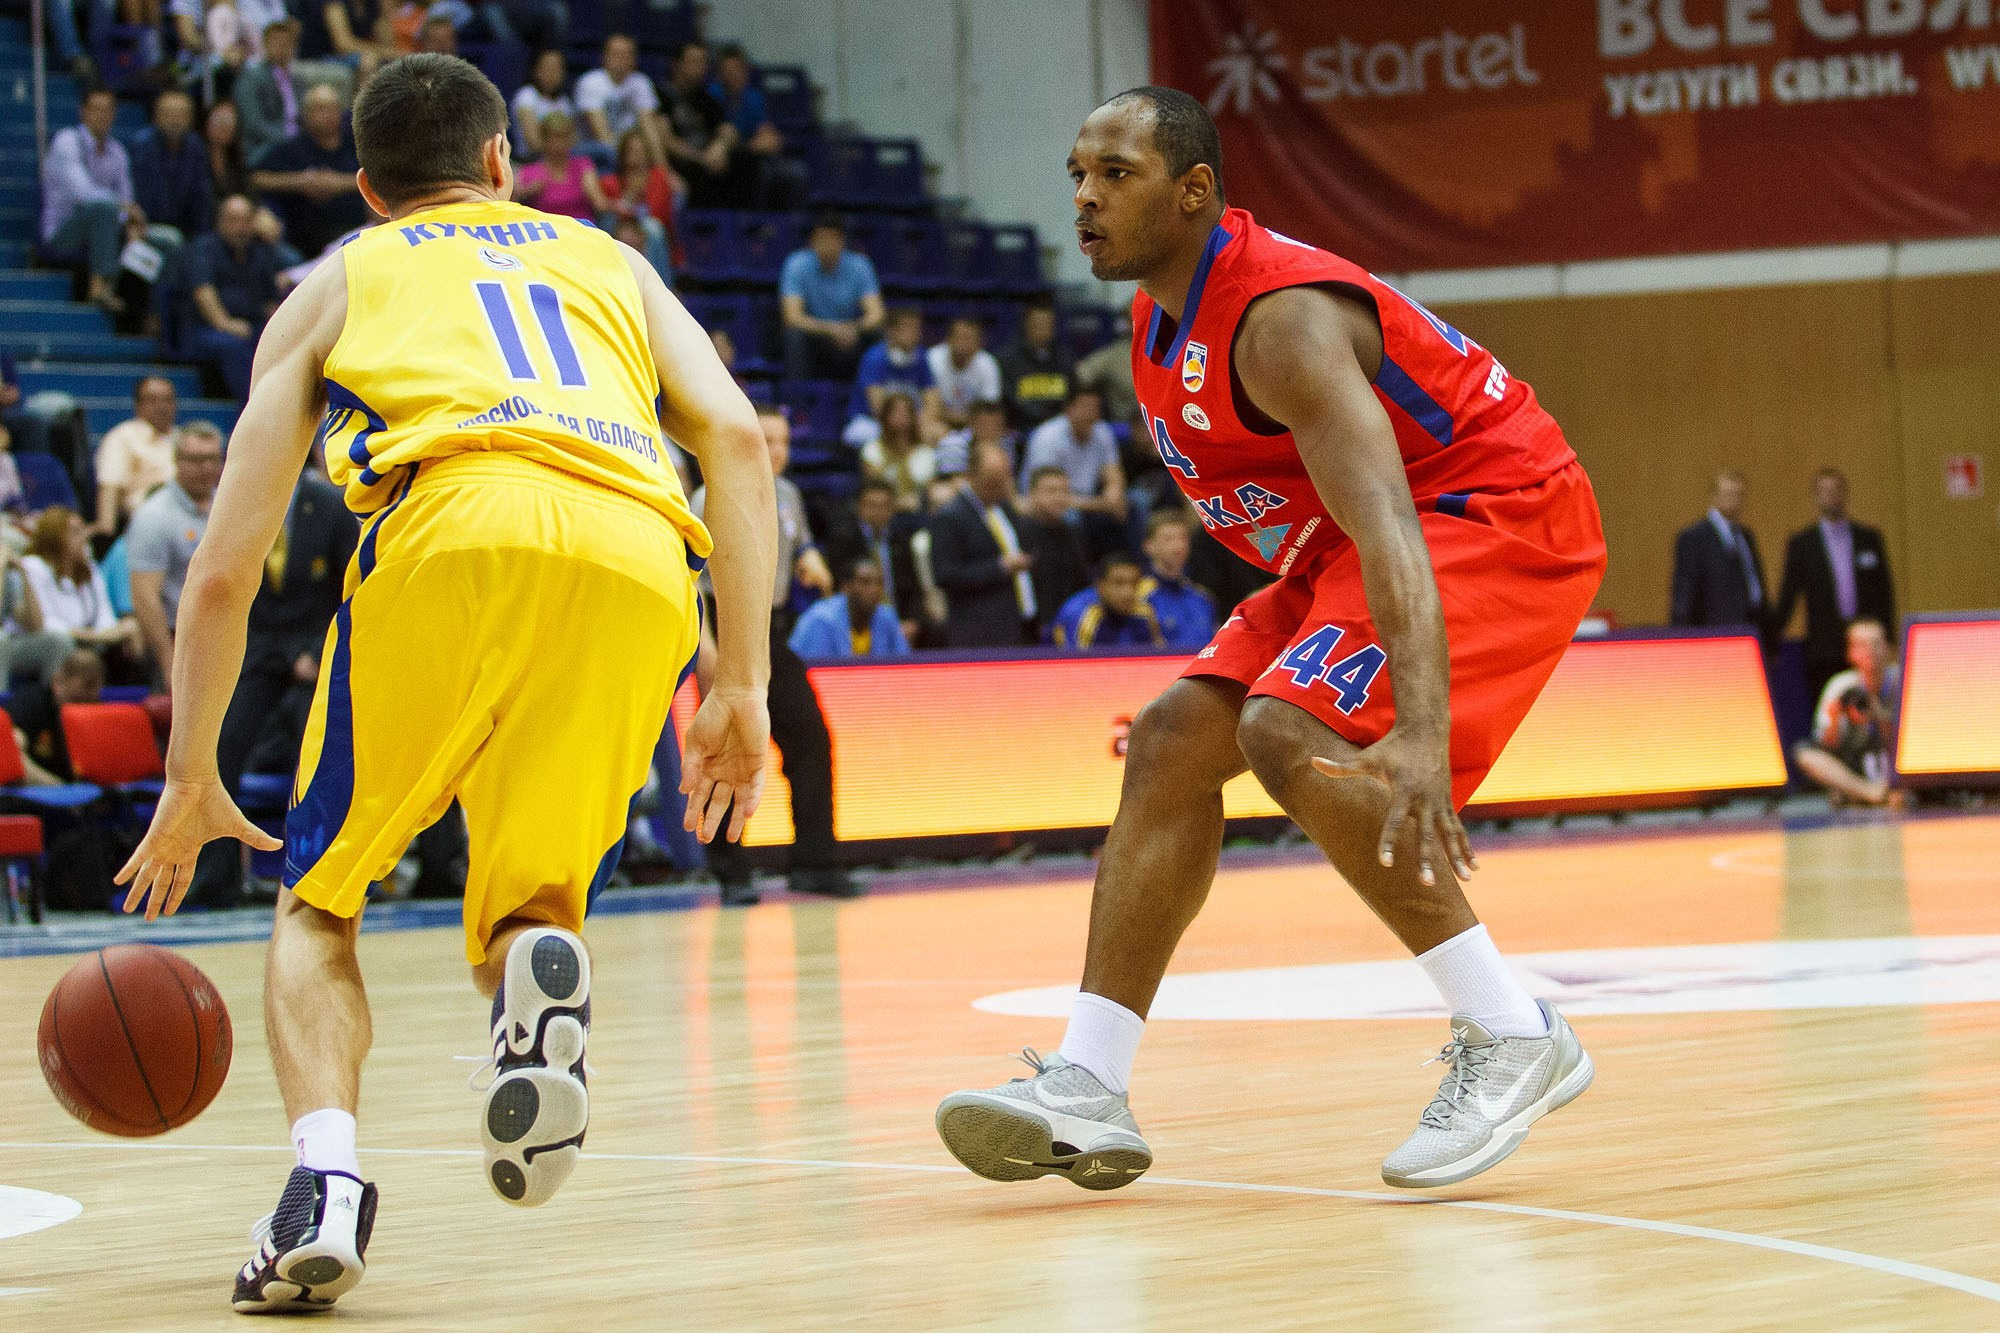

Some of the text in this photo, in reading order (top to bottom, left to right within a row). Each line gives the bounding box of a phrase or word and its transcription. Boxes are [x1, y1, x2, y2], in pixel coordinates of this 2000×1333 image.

[1598, 0, 1775, 57] ВСЕ
[1303, 22, 1540, 101] startel
[1603, 63, 1760, 117] УСЛУГИ
[474, 282, 588, 389] 11
[586, 416, 658, 464] ОБЛАСТЬ
[1294, 516, 1322, 548] НИКЕЛЬ
[1279, 624, 1389, 717] 44
